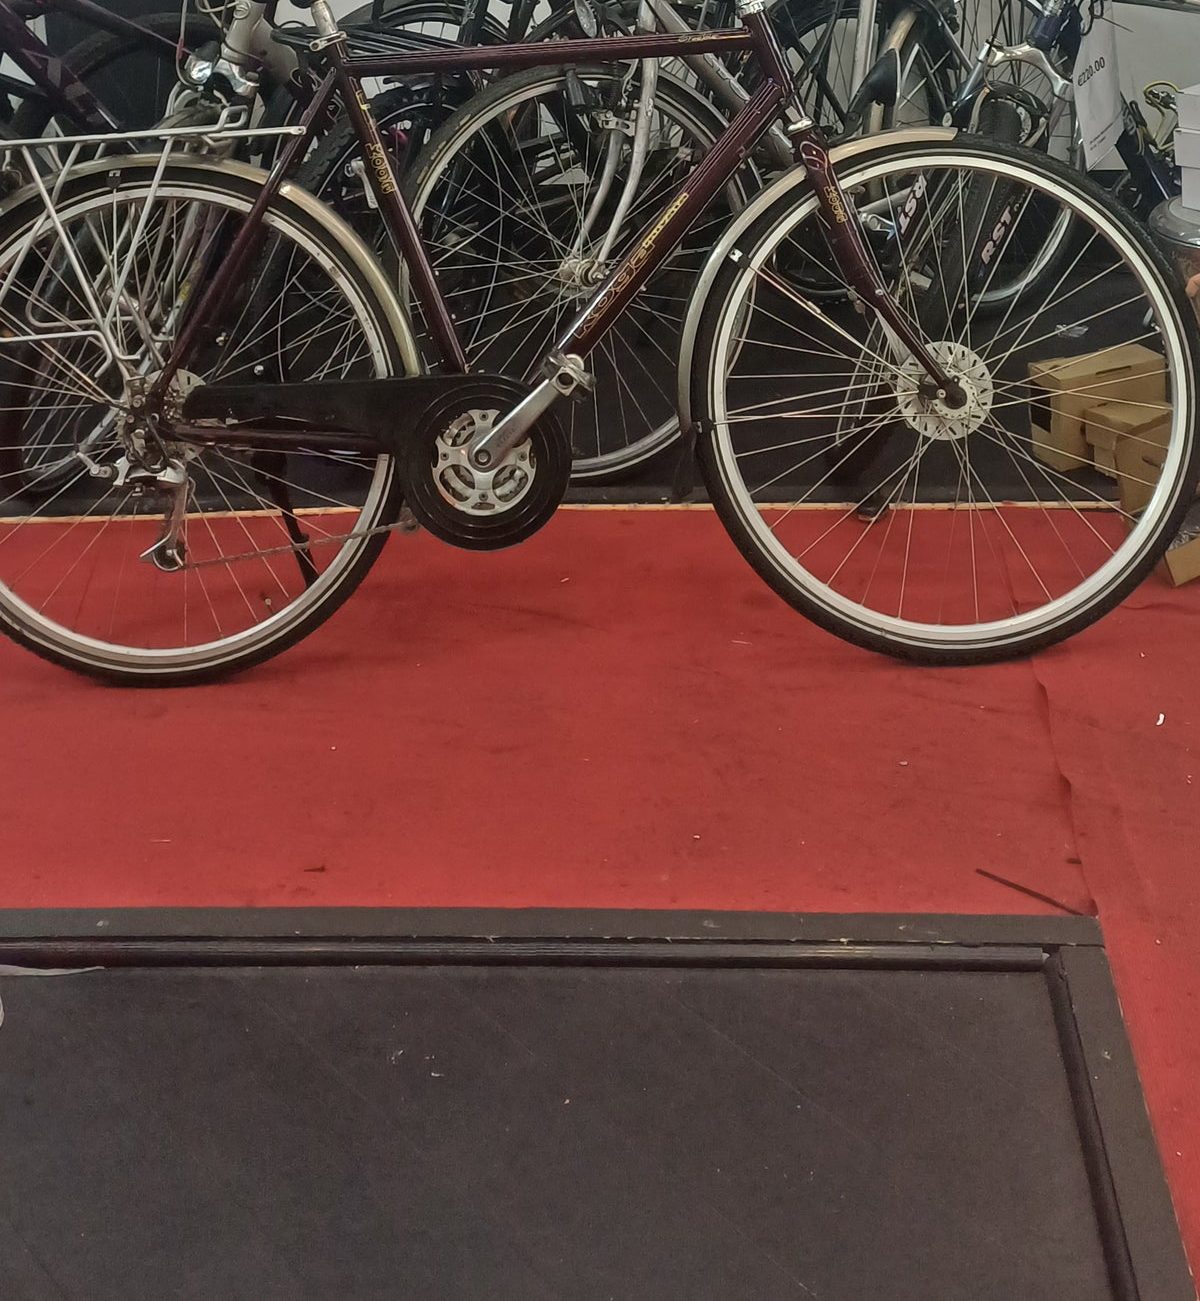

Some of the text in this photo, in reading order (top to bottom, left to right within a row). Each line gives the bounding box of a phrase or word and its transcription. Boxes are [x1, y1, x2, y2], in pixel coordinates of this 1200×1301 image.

[1077, 56, 1106, 87] €220.00
[899, 174, 927, 235] RST
[981, 205, 1012, 265] RST
